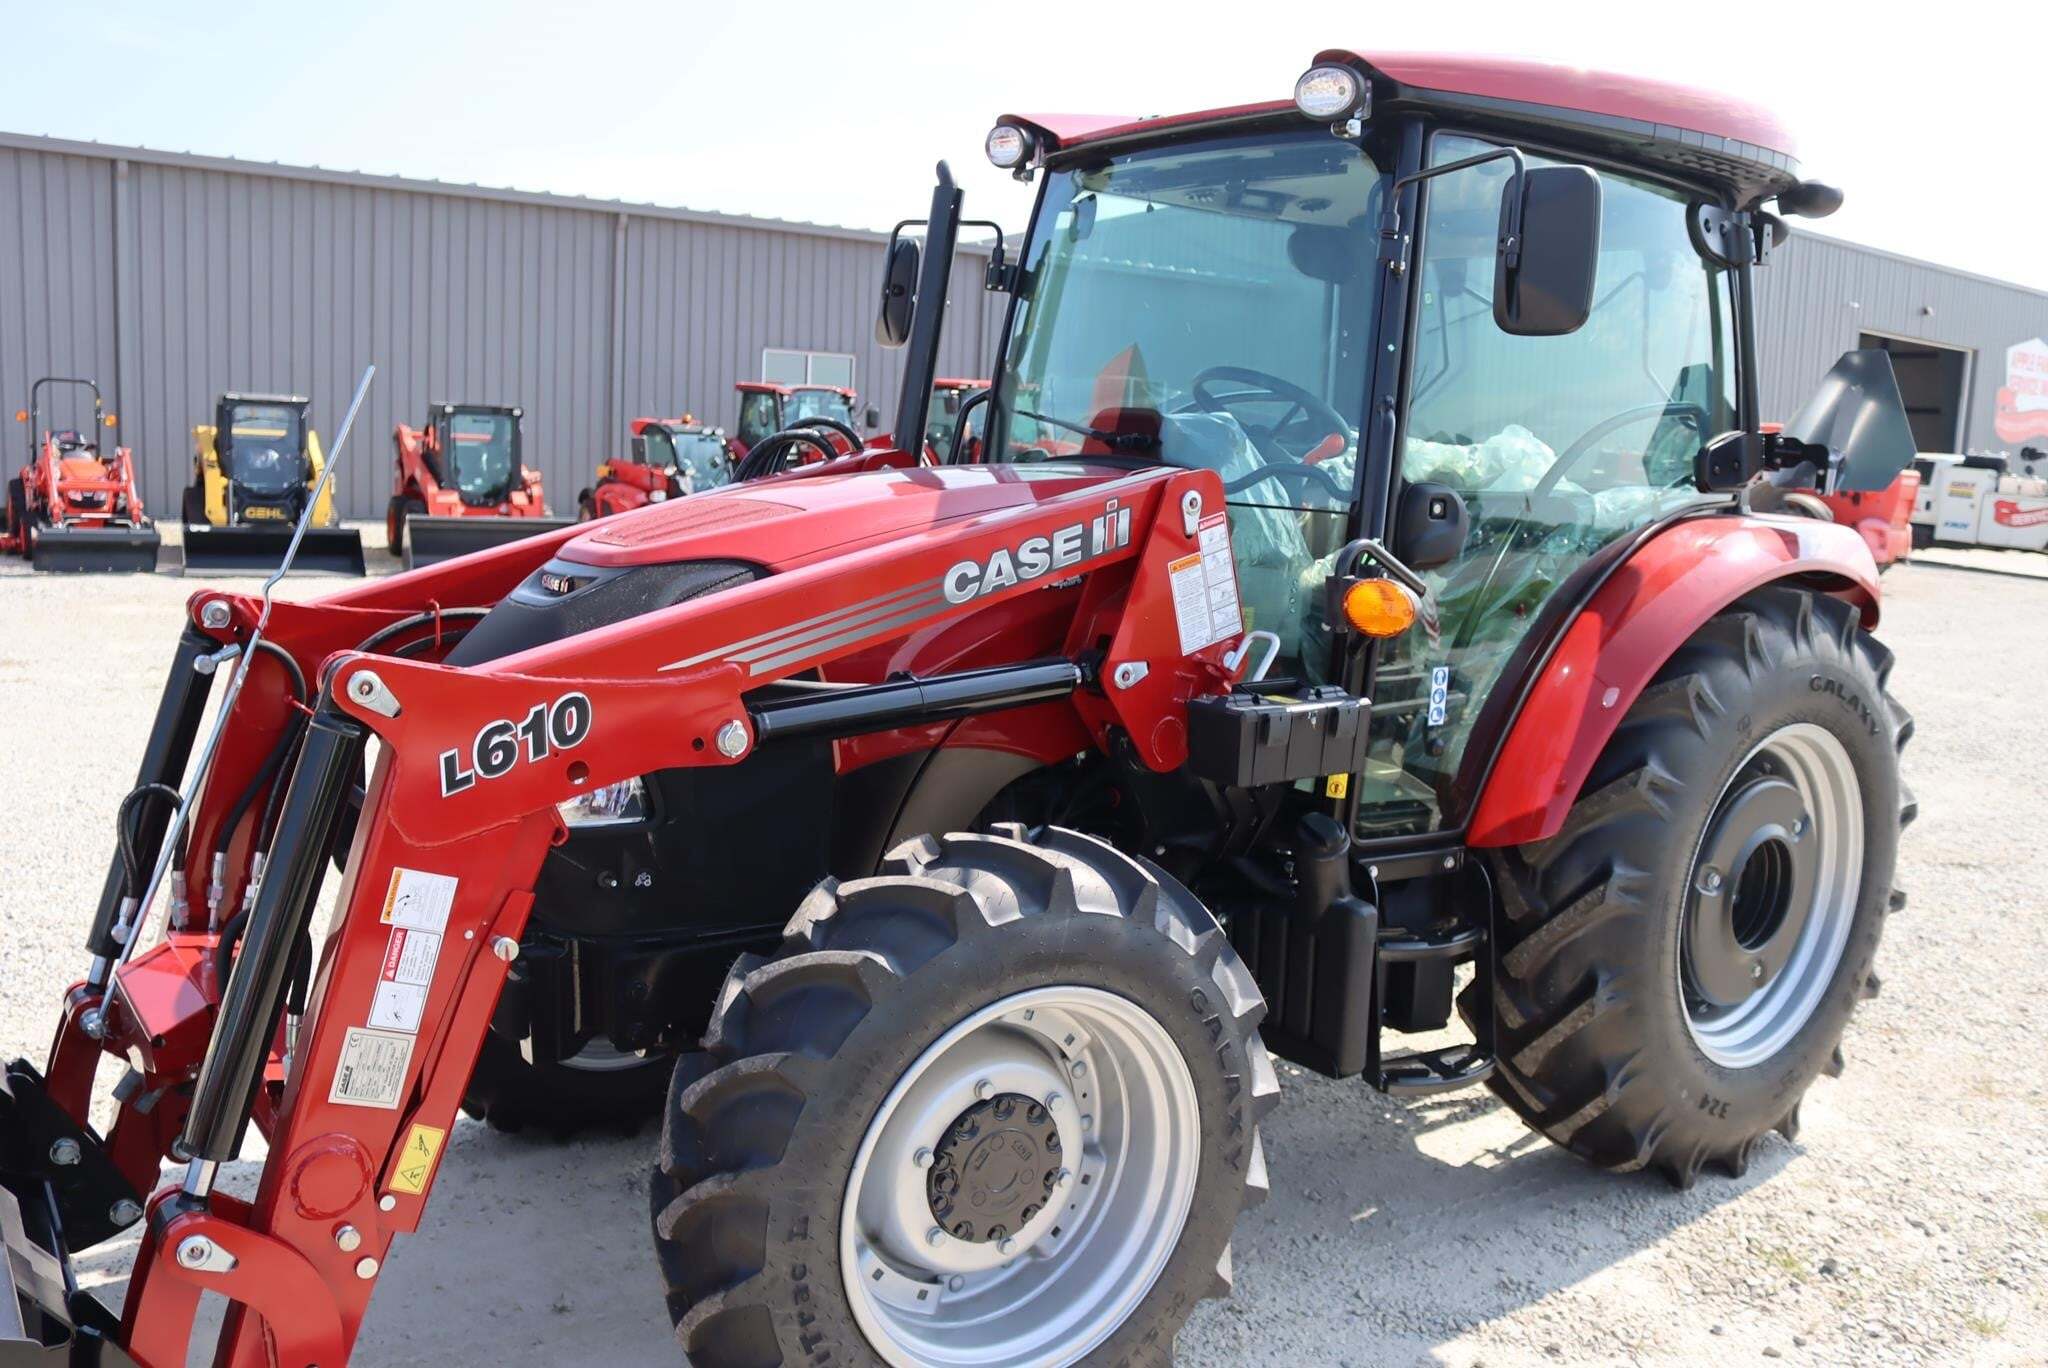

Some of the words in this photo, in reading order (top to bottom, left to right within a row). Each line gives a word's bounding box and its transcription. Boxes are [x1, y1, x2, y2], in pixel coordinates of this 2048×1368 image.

[245, 506, 287, 519] GEHL
[943, 523, 1084, 604] CASE
[1809, 675, 1879, 736] GALAXY
[439, 691, 592, 798] L610
[389, 931, 405, 968] DANGER
[1191, 985, 1243, 1171] GALAXY
